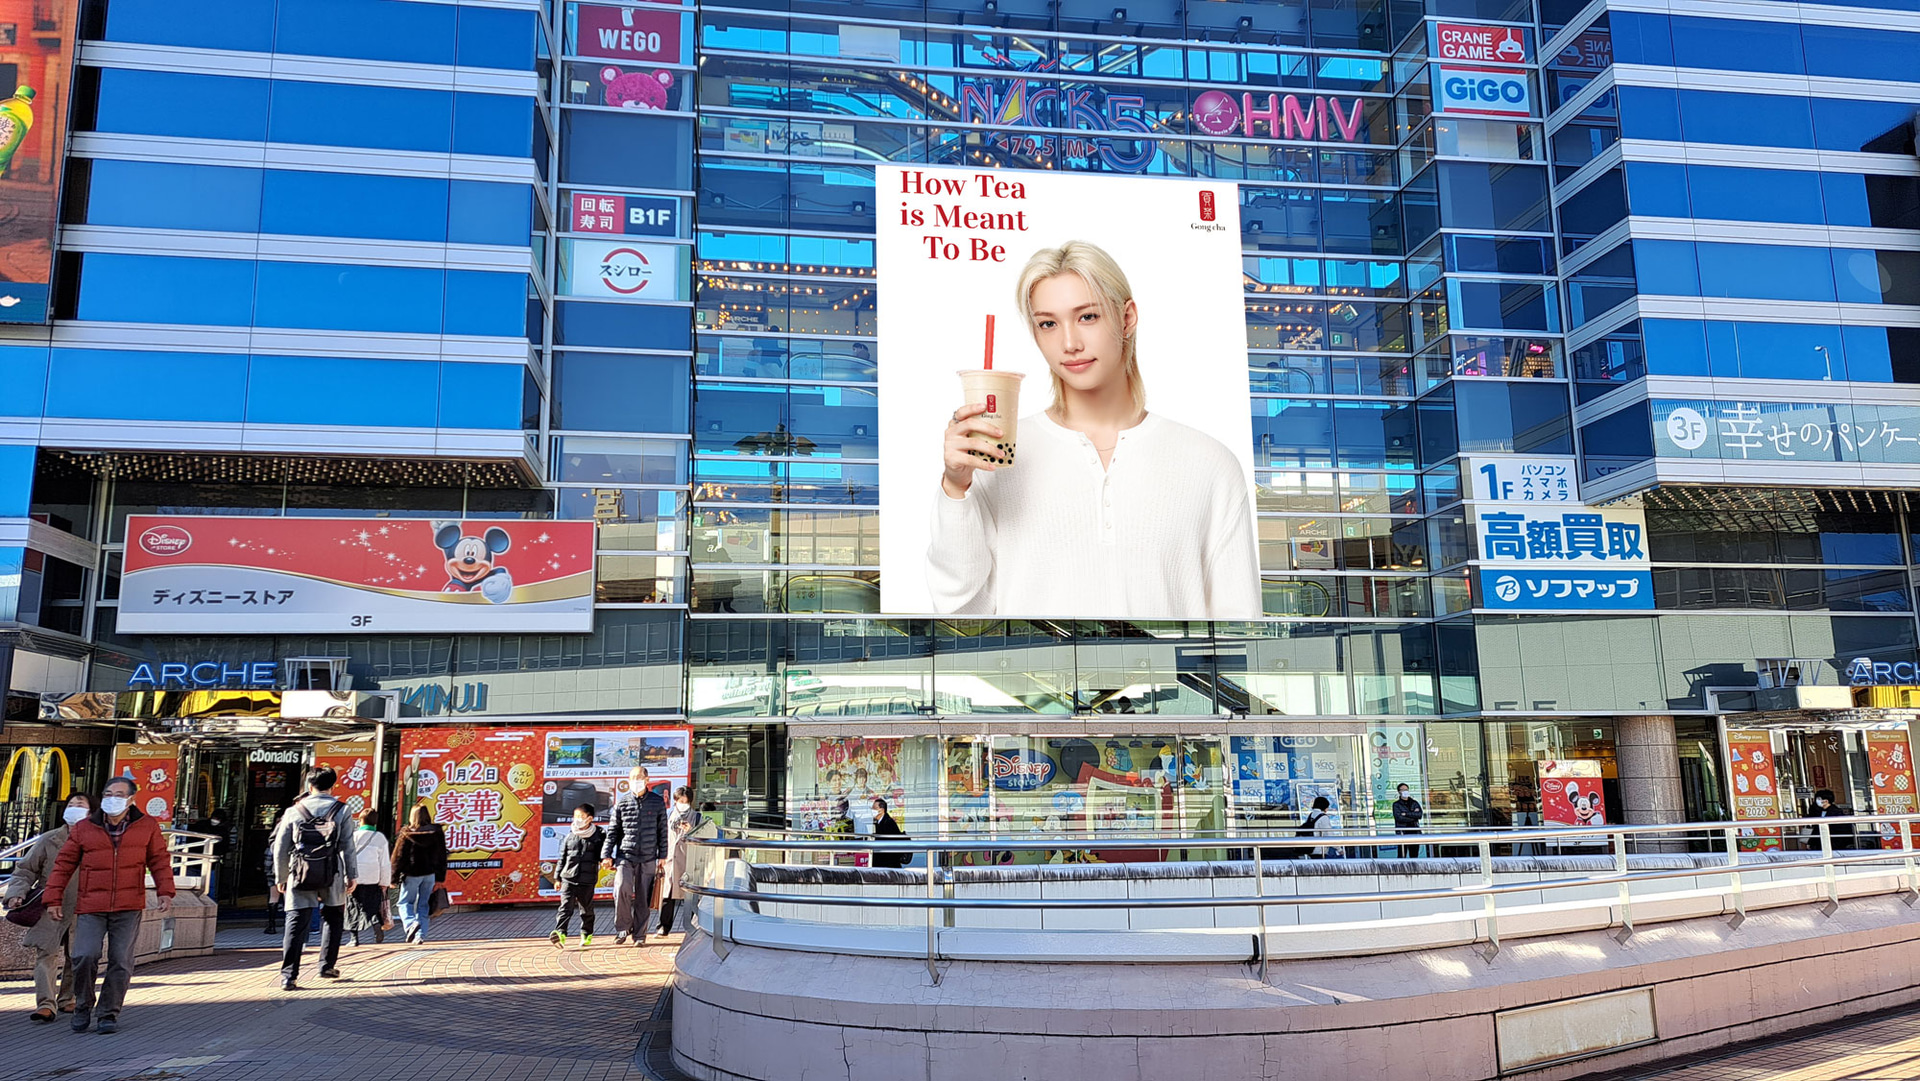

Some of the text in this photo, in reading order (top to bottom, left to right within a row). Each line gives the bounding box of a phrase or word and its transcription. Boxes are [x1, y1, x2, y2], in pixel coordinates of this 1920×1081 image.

[598, 28, 661, 53] WEGO
[1442, 30, 1492, 45] CRANE
[1443, 44, 1494, 60] GAME
[1445, 77, 1525, 103] GiGO
[1243, 92, 1363, 141] HMV
[900, 170, 1026, 199] How Tea
[581, 198, 615, 213] 回転
[580, 214, 613, 230] 寿司
[630, 207, 671, 226] B1F
[900, 202, 1029, 231] is Meant
[923, 236, 1006, 262] To Be
[599, 264, 652, 277] スシロー
[1673, 416, 1701, 441] 3F
[1719, 403, 1920, 459] 幸せのパンケー
[1521, 465, 1566, 476] パソコン
[1522, 478, 1567, 488] スマホ
[1524, 490, 1568, 501] カメラ
[145, 532, 186, 549] Disney
[1481, 512, 1644, 560] 高額買取
[1526, 578, 1639, 598] ソフマップ
[153, 589, 294, 605] ディズニーストア
[350, 616, 372, 626] 3F
[127, 662, 278, 686] ARCHE
[1733, 732, 1752, 741] Disney
[1871, 732, 1890, 741] Disney
[128, 747, 154, 756] Disney
[326, 744, 351, 755] Disney
[444, 762, 496, 781] 1月2日
[993, 755, 1050, 782] Disney
[1008, 778, 1036, 787] store
[437, 790, 498, 822] 豪華
[1739, 797, 1772, 806] NEW YEAR
[1879, 795, 1911, 805] NEW YEAR
[1746, 807, 1767, 817] 2026
[1886, 804, 1906, 815] 2026
